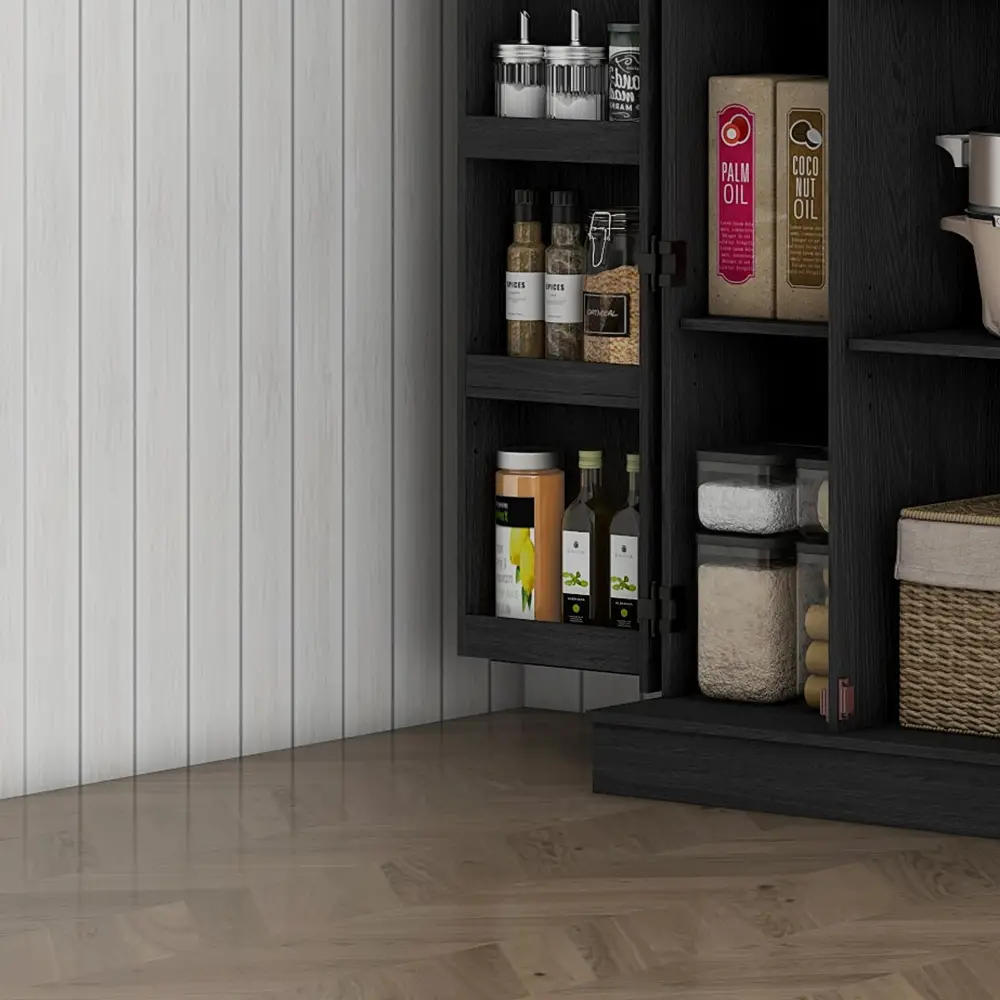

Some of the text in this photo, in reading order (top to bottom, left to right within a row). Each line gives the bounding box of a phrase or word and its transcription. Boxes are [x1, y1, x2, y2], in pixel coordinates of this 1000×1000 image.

[721, 162, 750, 183] PALM
[792, 155, 819, 177] COCO
[723, 183, 748, 205] OIL
[795, 177, 816, 198] NUT
[793, 198, 818, 220] OIL
